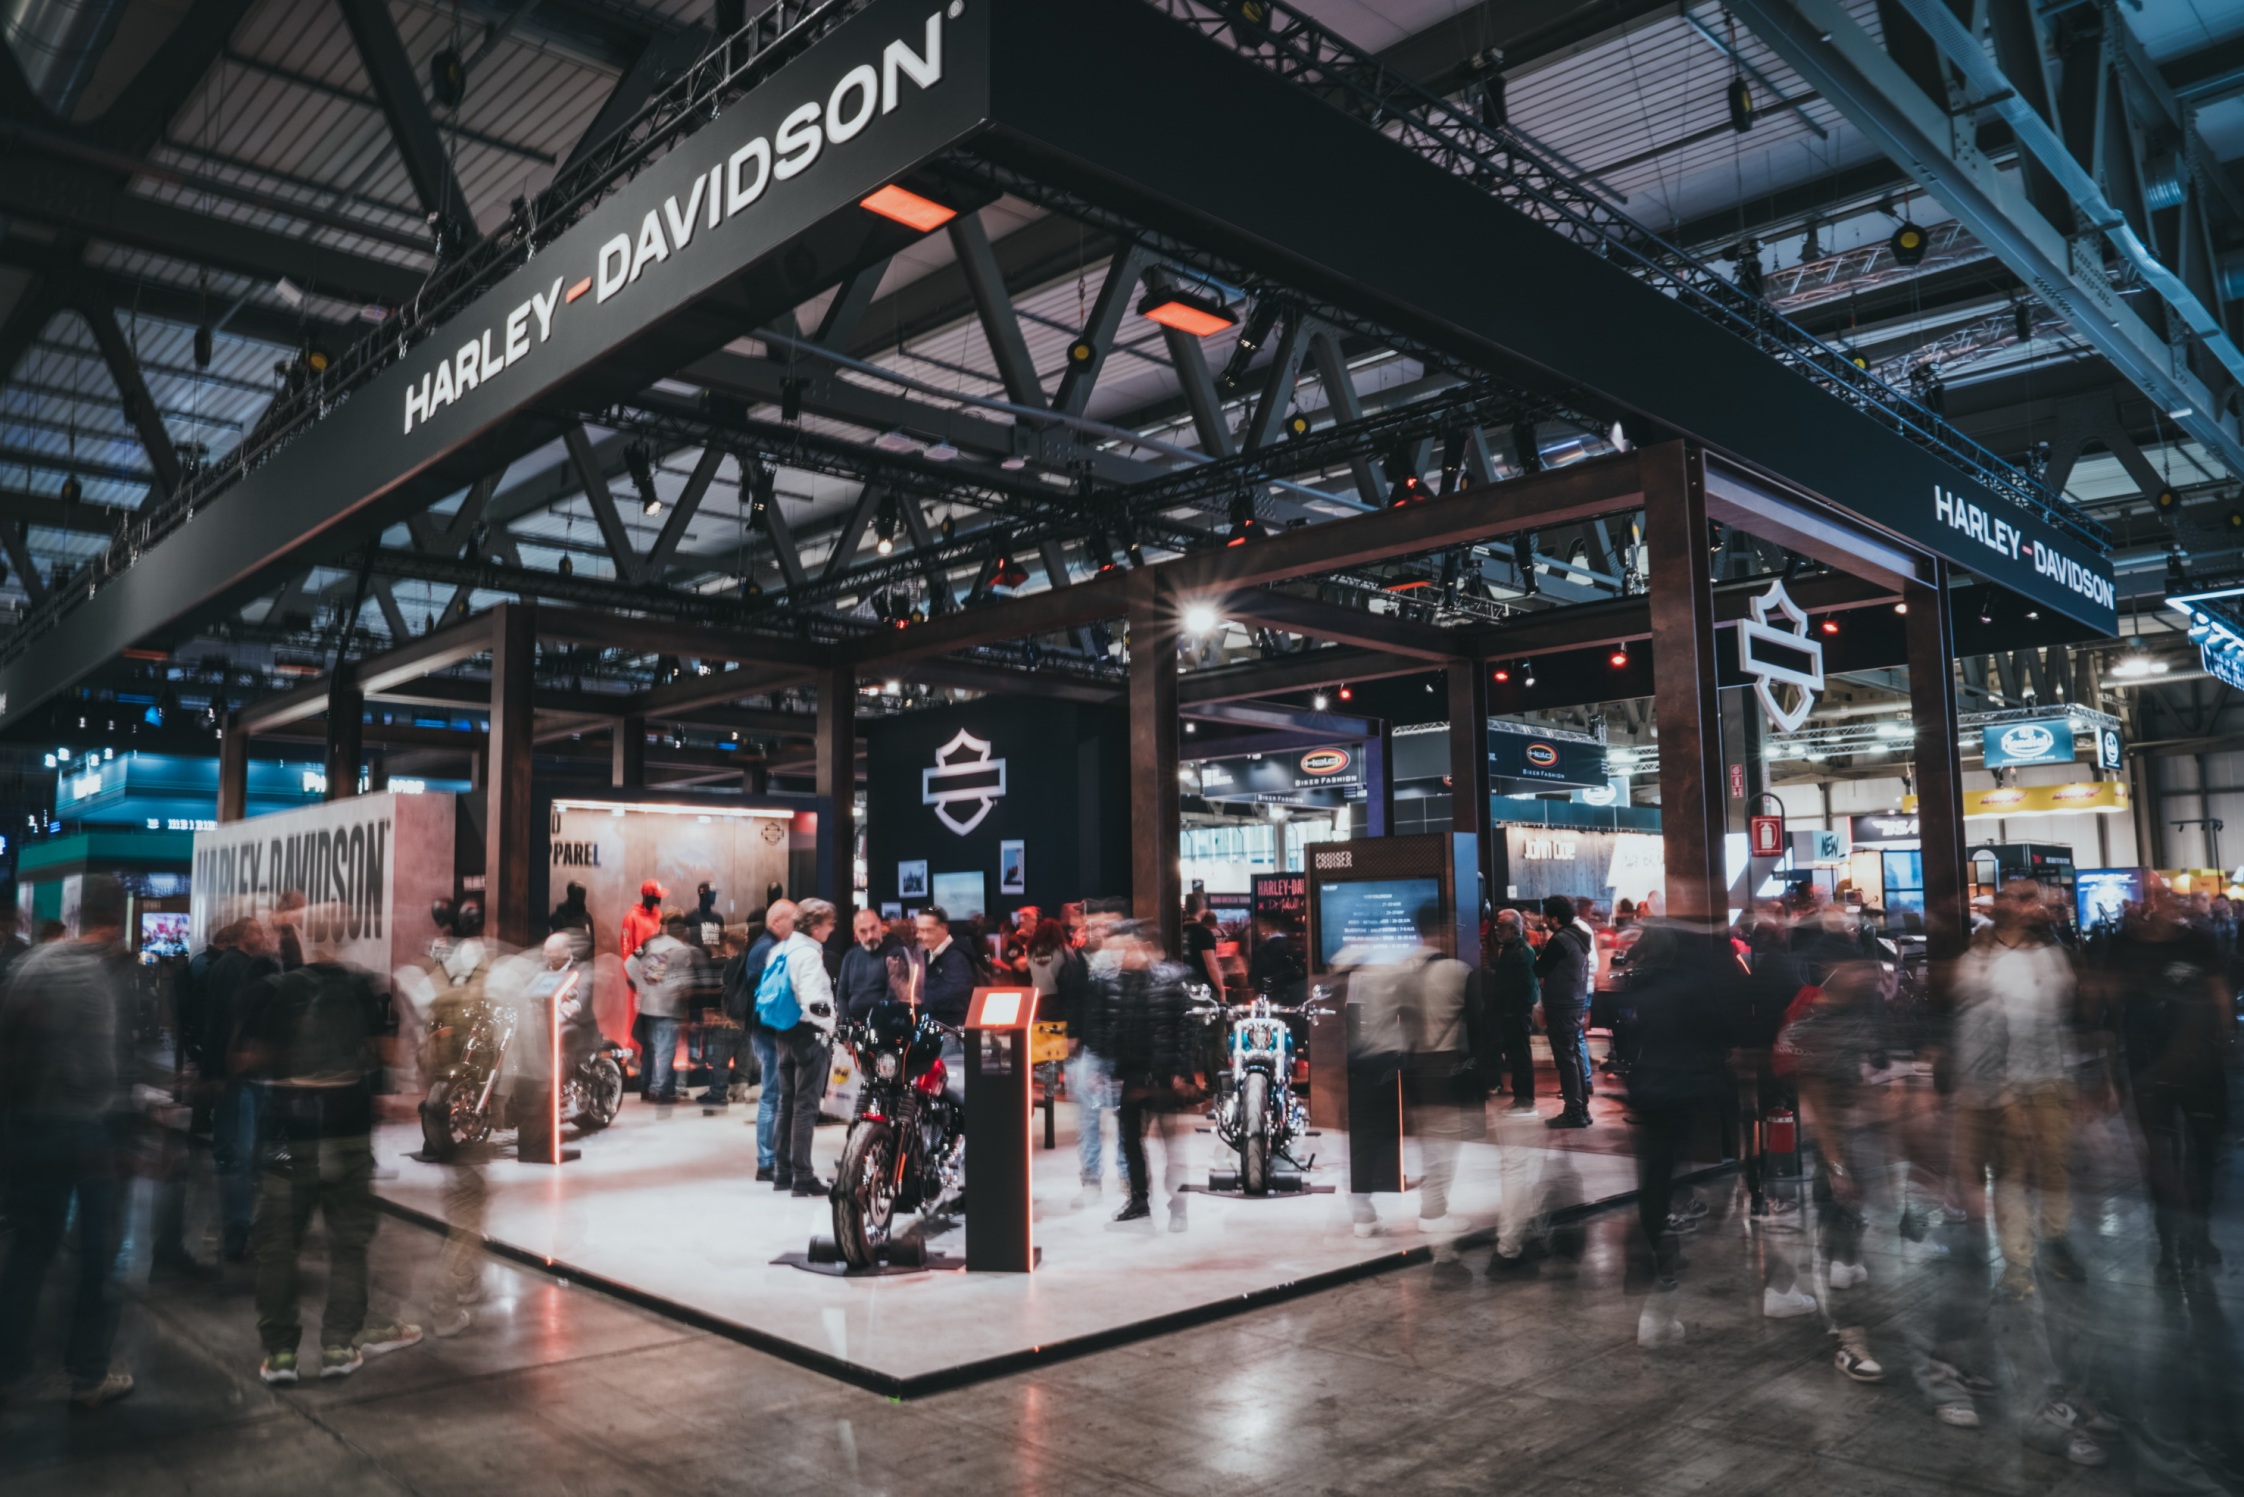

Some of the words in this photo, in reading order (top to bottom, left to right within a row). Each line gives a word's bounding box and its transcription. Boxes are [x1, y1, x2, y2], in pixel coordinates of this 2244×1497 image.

[404, 10, 943, 434] HARLEY-DAVIDSON
[1934, 484, 2114, 610] HARLEY-DAVIDSON
[550, 842, 601, 866] PAREL
[1524, 838, 1552, 860] John
[1553, 839, 1575, 860] Doe
[1821, 835, 1840, 858] NEW
